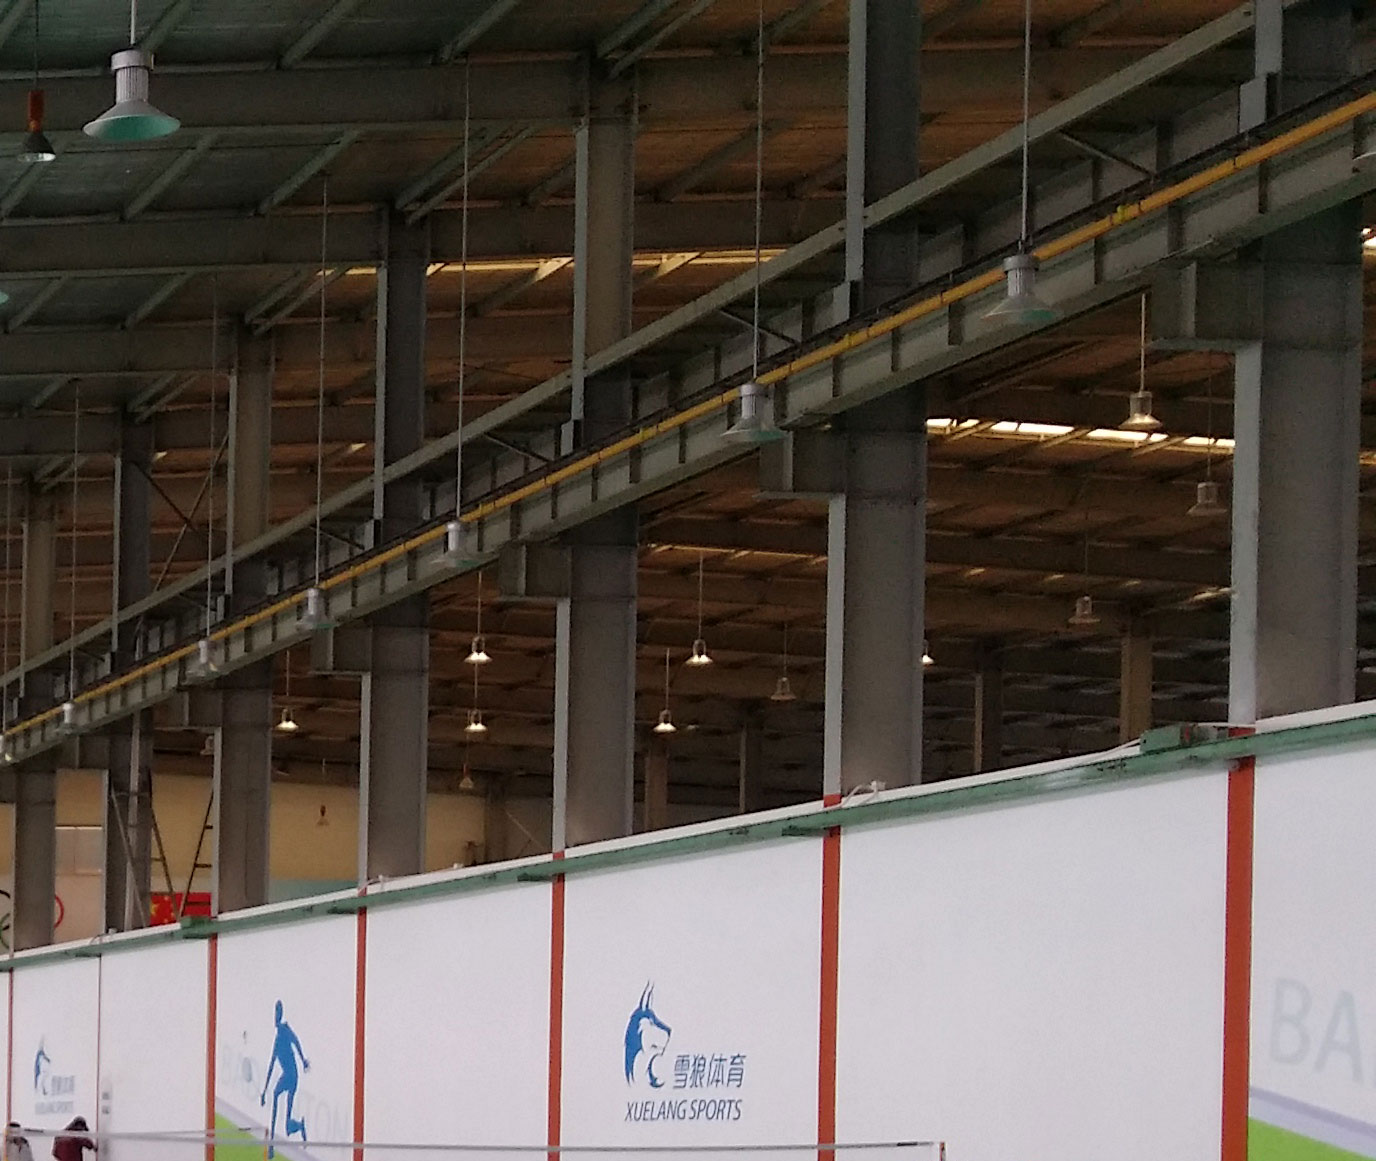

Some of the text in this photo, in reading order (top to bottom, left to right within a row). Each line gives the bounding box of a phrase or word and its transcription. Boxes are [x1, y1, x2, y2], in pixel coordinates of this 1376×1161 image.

[1269, 976, 1376, 1089] BA
[674, 1053, 747, 1090] 雪狼体育
[624, 1098, 743, 1122] XUELANG SPORTS
